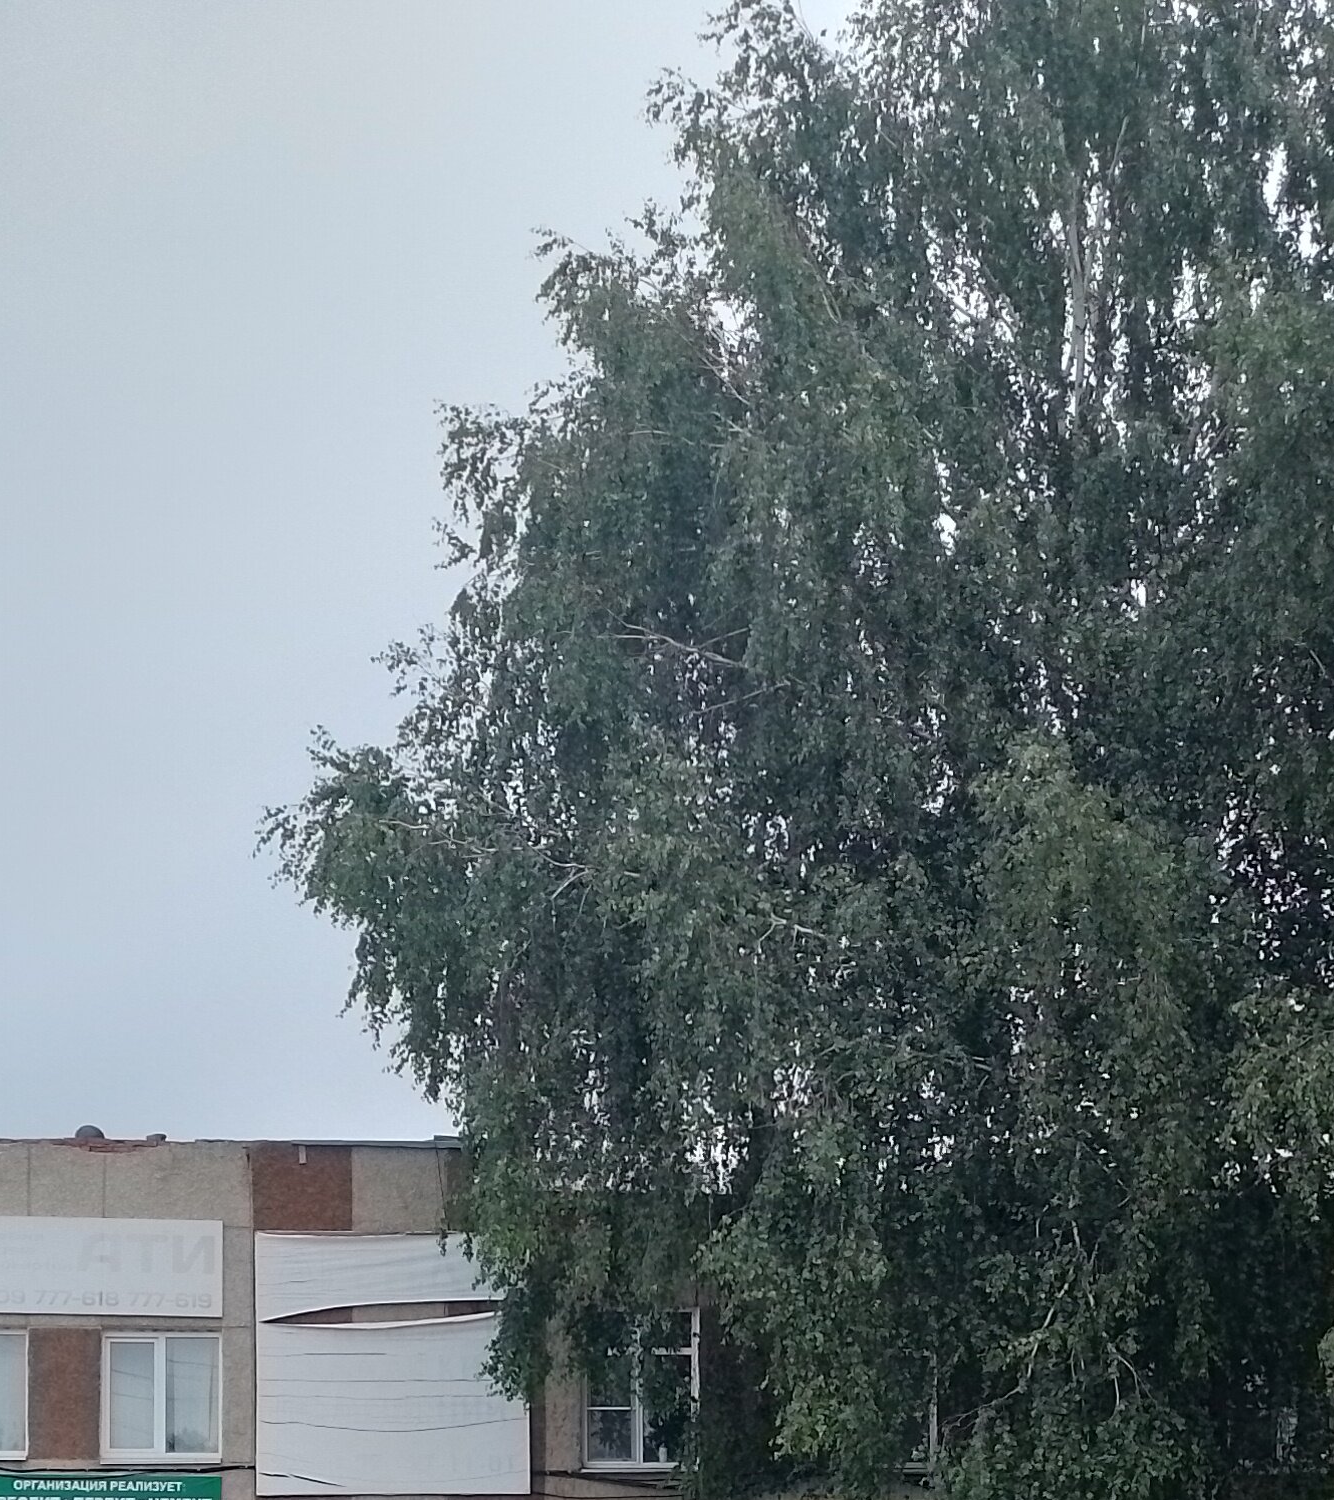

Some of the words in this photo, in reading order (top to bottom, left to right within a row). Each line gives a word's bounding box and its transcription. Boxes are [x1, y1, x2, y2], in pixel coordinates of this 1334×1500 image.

[77, 1232, 215, 1275] АТИ
[35, 1289, 119, 1306] 777-618
[13, 1479, 108, 1492] ОРГАНИЗАЦИЯ
